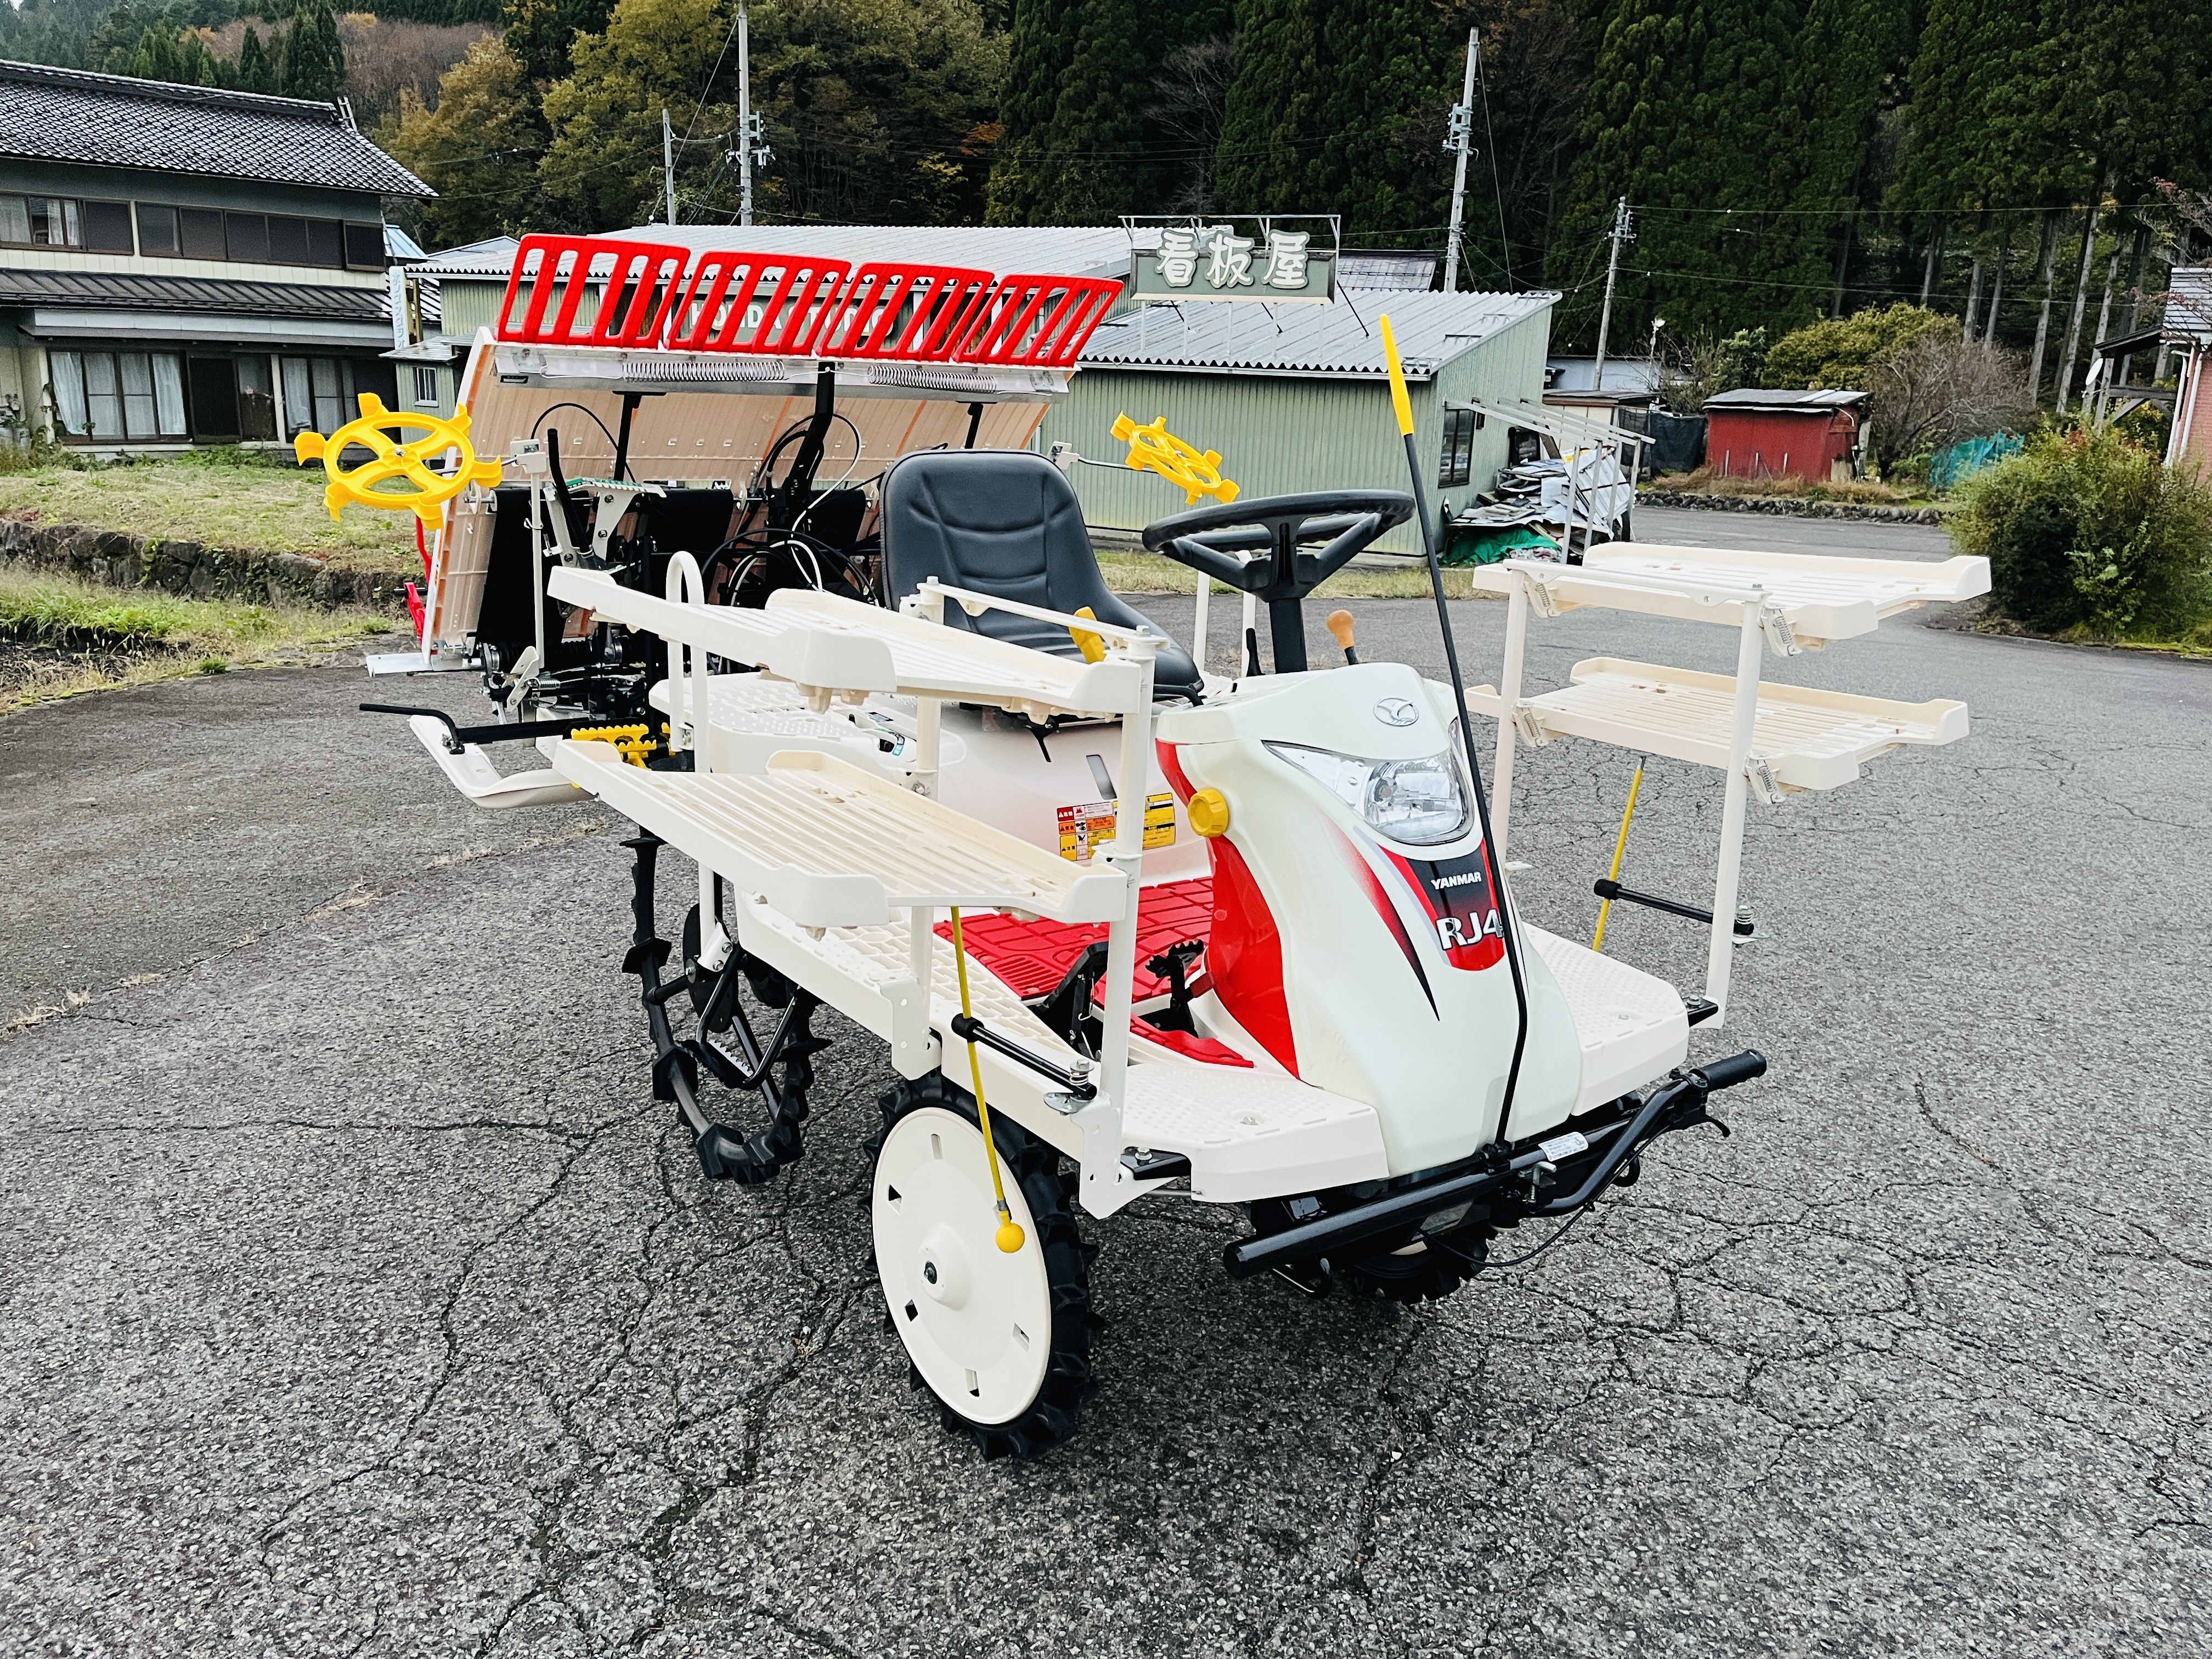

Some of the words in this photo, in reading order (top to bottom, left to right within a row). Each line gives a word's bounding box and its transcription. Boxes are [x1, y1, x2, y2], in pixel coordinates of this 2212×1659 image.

[1156, 230, 1308, 286] 看板屋
[1431, 872, 1482, 890] YANMAR
[1435, 909, 1503, 950] RJ4
